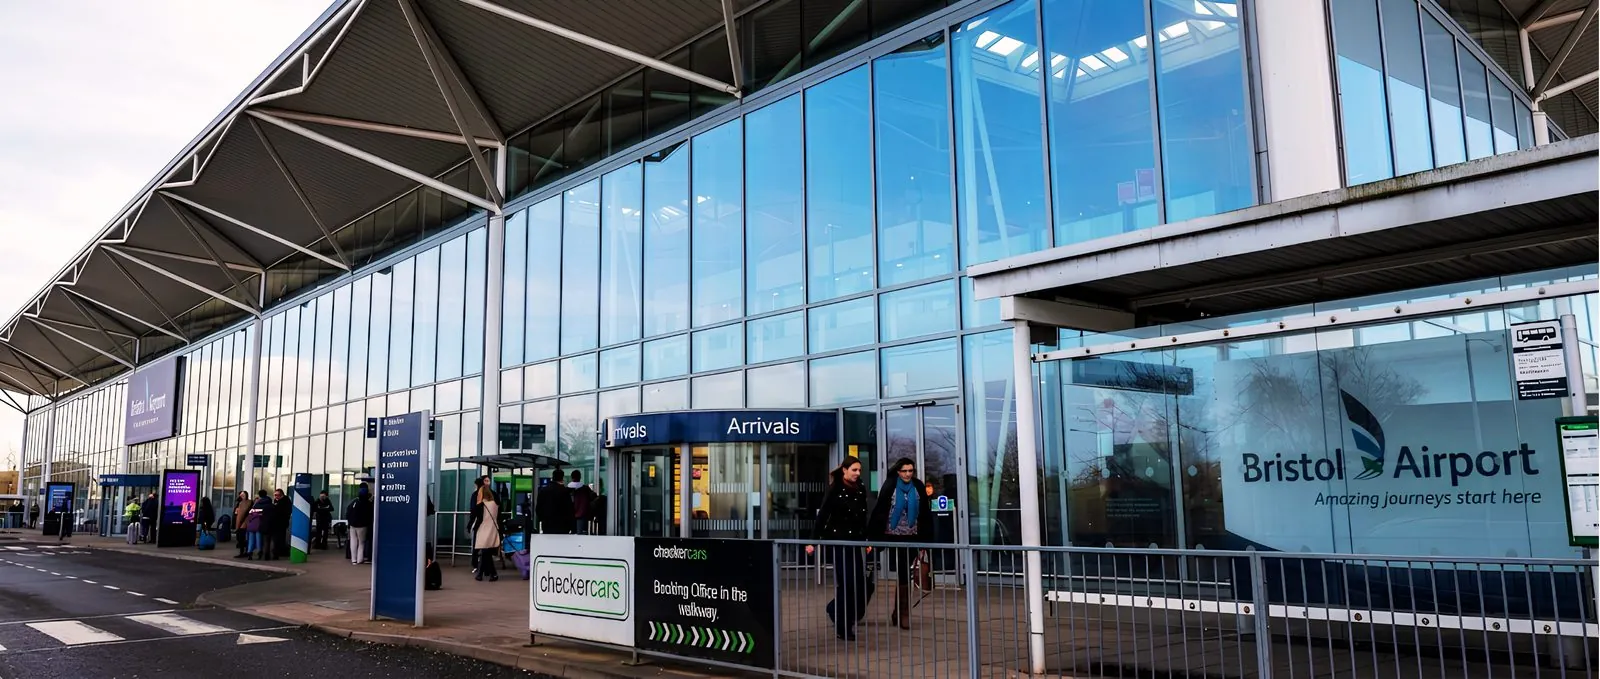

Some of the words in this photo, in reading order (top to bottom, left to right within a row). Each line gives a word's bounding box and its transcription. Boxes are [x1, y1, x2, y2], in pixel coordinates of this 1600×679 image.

[727, 417, 800, 435] Arrivals
[1242, 448, 1344, 483] Bristol
[1393, 443, 1540, 487] Airport
[1314, 491, 1379, 509] Amazing
[1381, 491, 1452, 509] journeys
[1456, 490, 1497, 505] start
[1502, 488, 1542, 504] here
[540, 570, 620, 600] checkercars
[654, 579, 689, 600] Booking
[691, 582, 718, 600] Office
[720, 585, 730, 601] in
[731, 586, 748, 602] the
